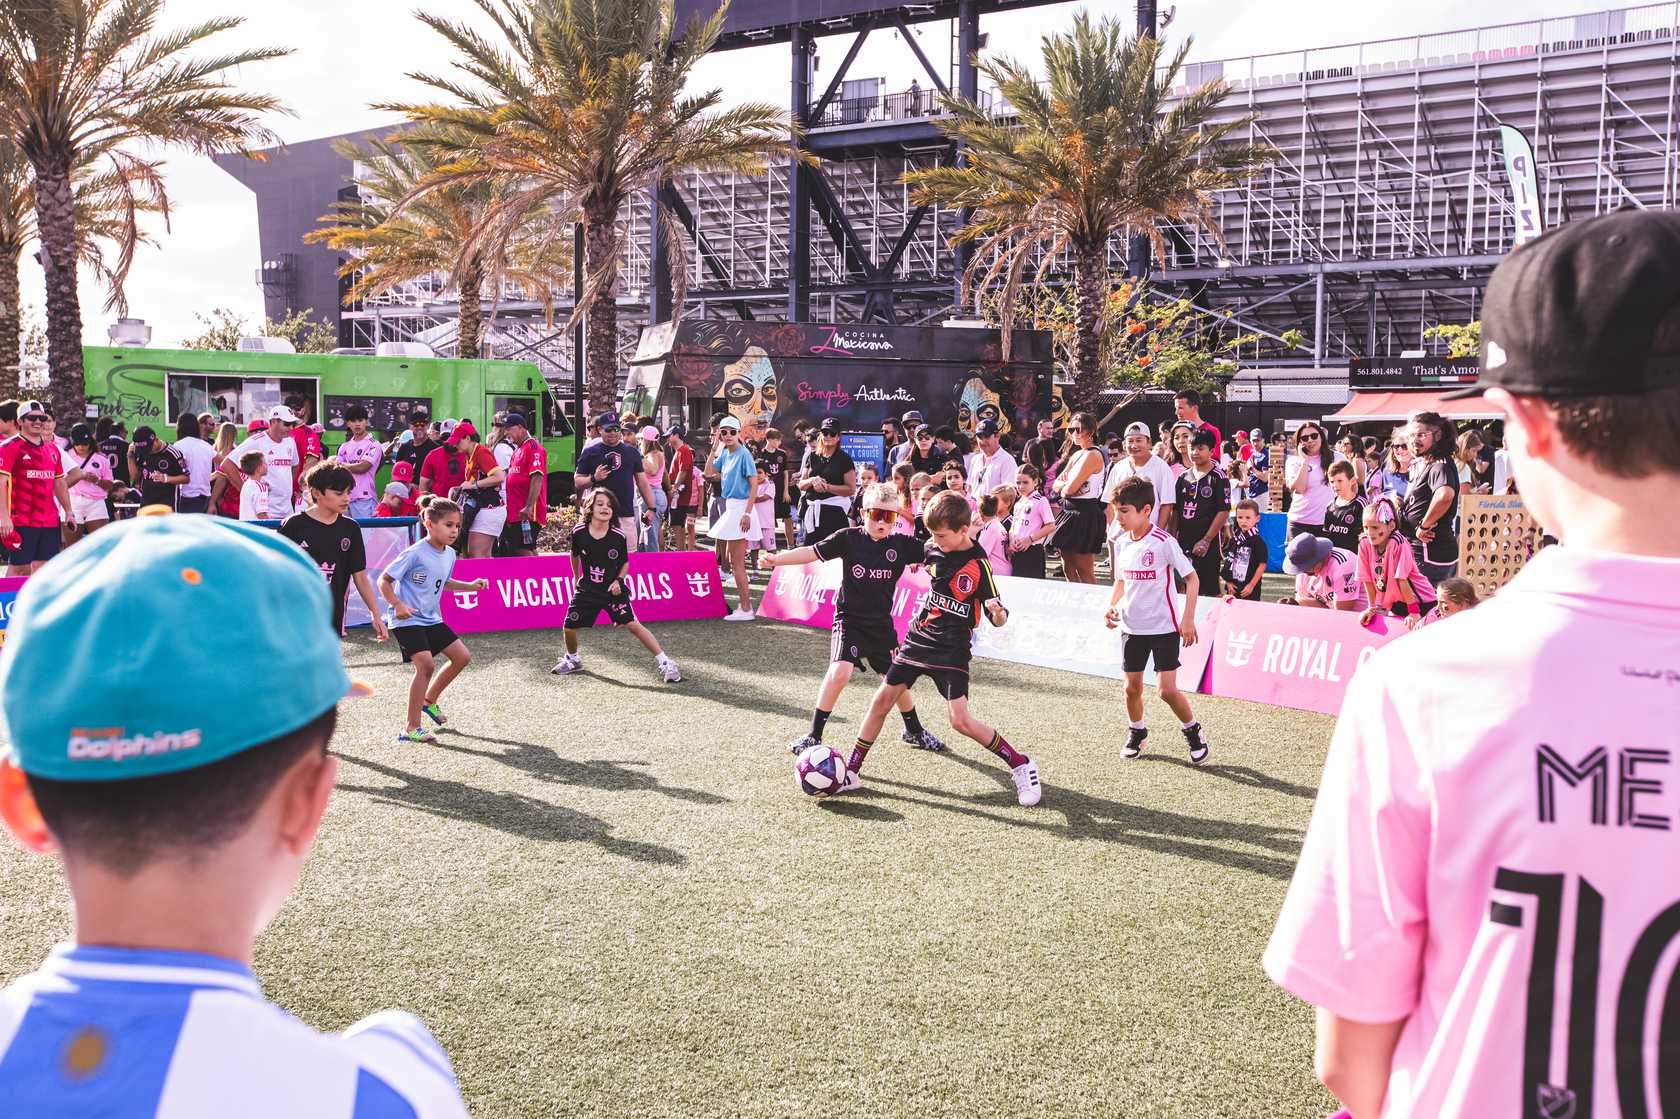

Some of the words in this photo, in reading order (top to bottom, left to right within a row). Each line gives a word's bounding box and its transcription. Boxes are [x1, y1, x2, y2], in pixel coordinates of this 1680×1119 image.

[1413, 366, 1446, 375] That's
[797, 382, 852, 416] Simply
[854, 385, 915, 401] Authentic
[857, 449, 879, 458] CRUISE
[869, 569, 892, 579] XBTO
[434, 579, 442, 595] 9
[497, 576, 576, 608] VACATI
[624, 573, 673, 600] OALS
[932, 592, 967, 614] URINA
[1262, 634, 1342, 683] ROYAL
[68, 729, 201, 761] Dolphins
[1536, 744, 1671, 831] ME
